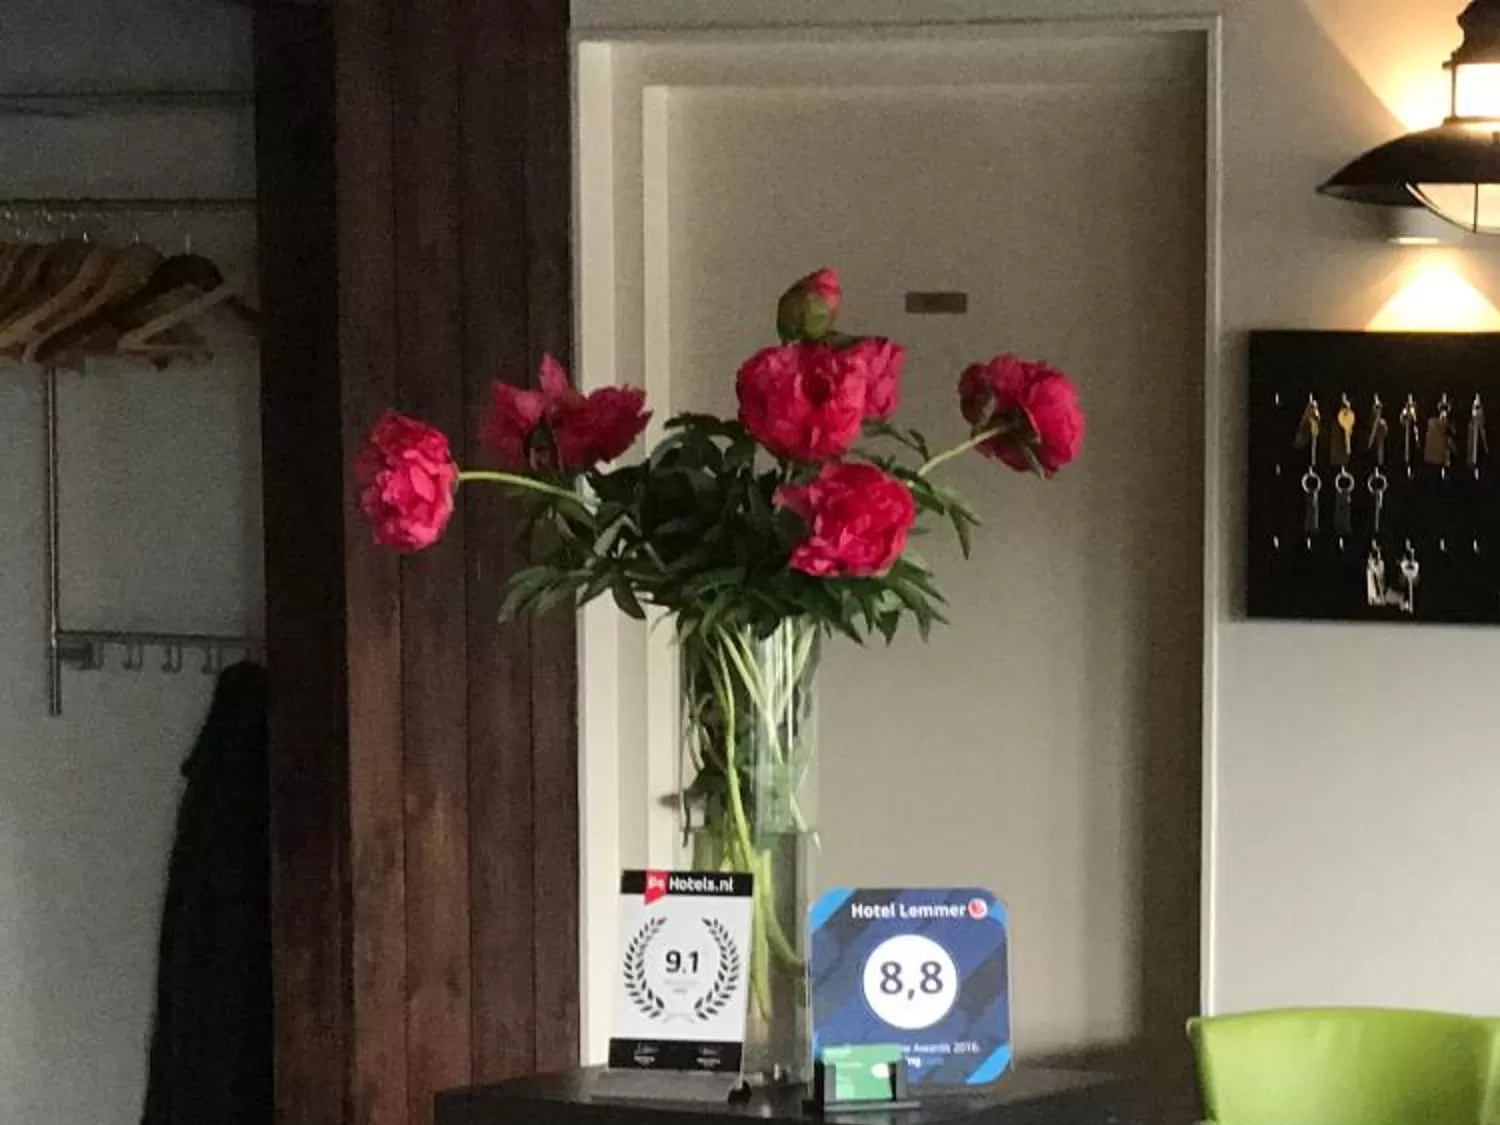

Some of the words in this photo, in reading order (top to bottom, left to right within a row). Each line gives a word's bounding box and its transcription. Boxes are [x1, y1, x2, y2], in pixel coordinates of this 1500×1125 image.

[668, 875, 735, 893] Hotels.nl
[851, 902, 896, 919] Hotel
[899, 902, 967, 919] Lemmer
[665, 949, 700, 974] 9.1
[879, 960, 944, 1000] 8,8
